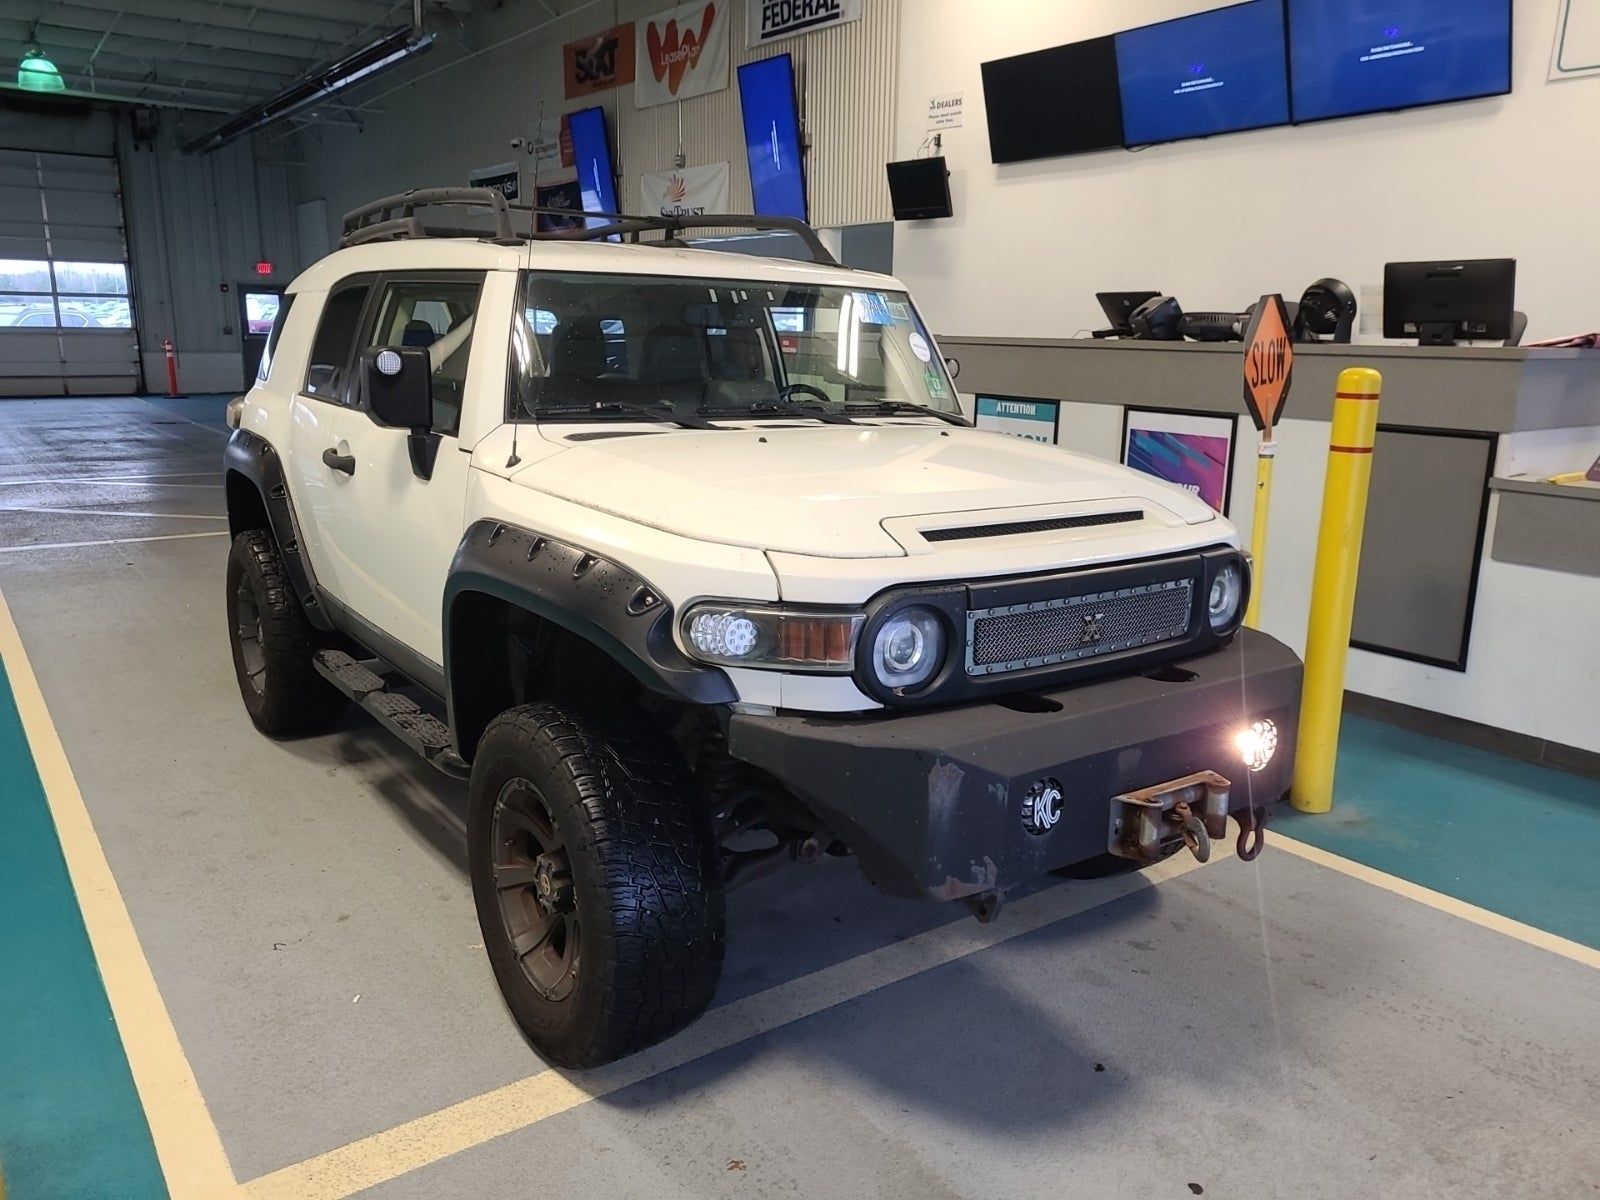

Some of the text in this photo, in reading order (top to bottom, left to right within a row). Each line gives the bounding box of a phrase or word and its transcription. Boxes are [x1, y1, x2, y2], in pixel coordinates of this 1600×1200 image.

[762, 0, 839, 31] FEDERAL
[936, 97, 962, 109] DEALERS
[1251, 336, 1286, 388] SLOW
[996, 402, 1036, 416] ATTENTION
[1034, 788, 1061, 829] KC
